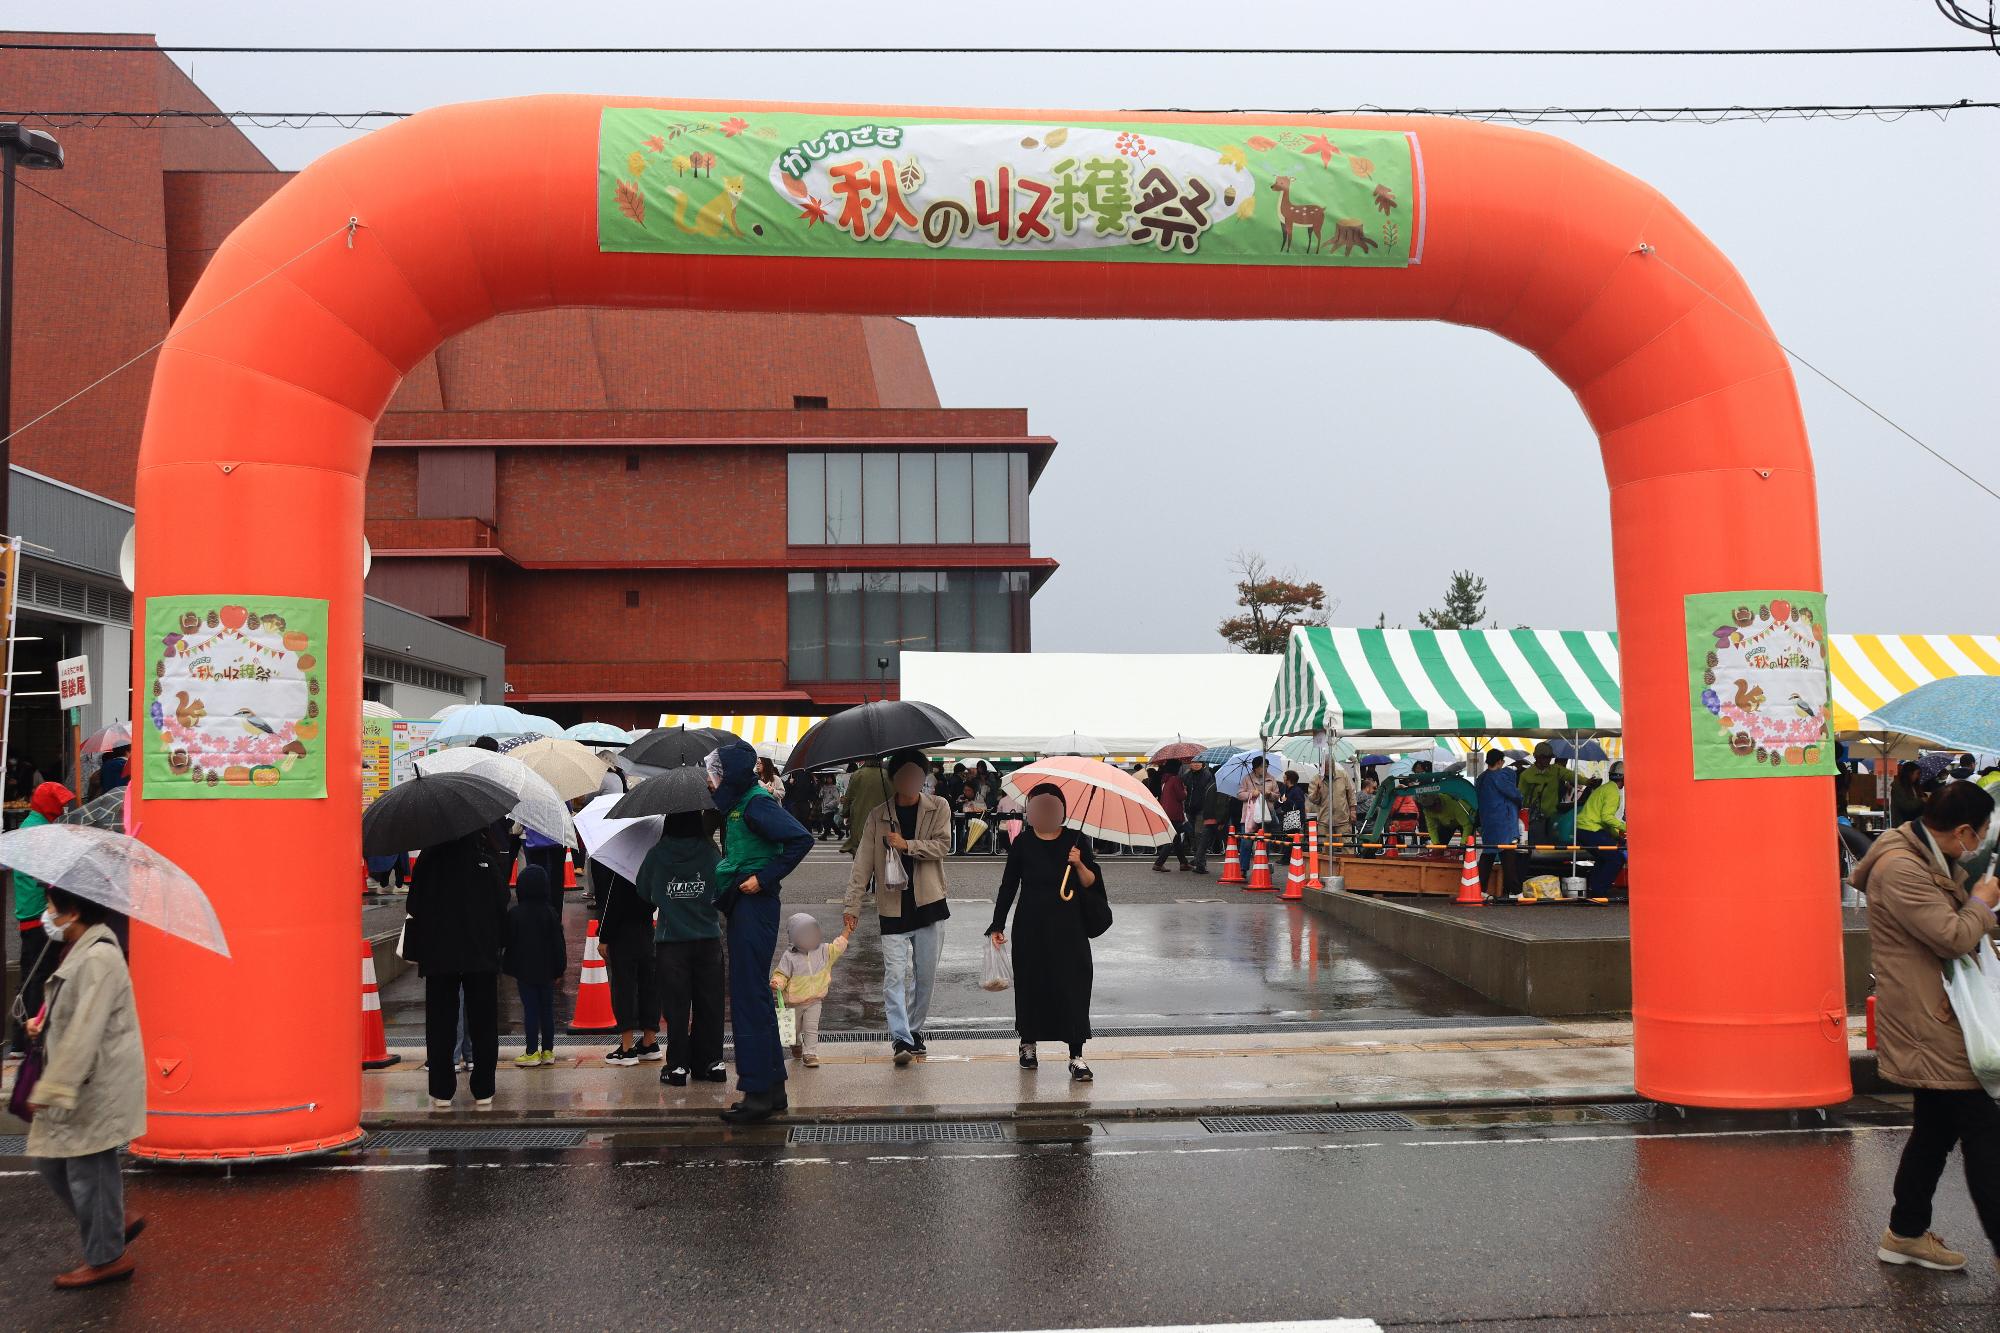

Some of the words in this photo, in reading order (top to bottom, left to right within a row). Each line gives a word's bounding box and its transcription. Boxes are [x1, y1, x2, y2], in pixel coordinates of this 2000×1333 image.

[782, 125, 901, 178] かしわざき
[828, 158, 1212, 250] 秋の収穫祭
[1754, 653, 1809, 669] 秋の収穫祭
[196, 663, 271, 682] 秋の収穫祭
[61, 675, 87, 699] 最後尾
[667, 881, 705, 893] XLARGE
